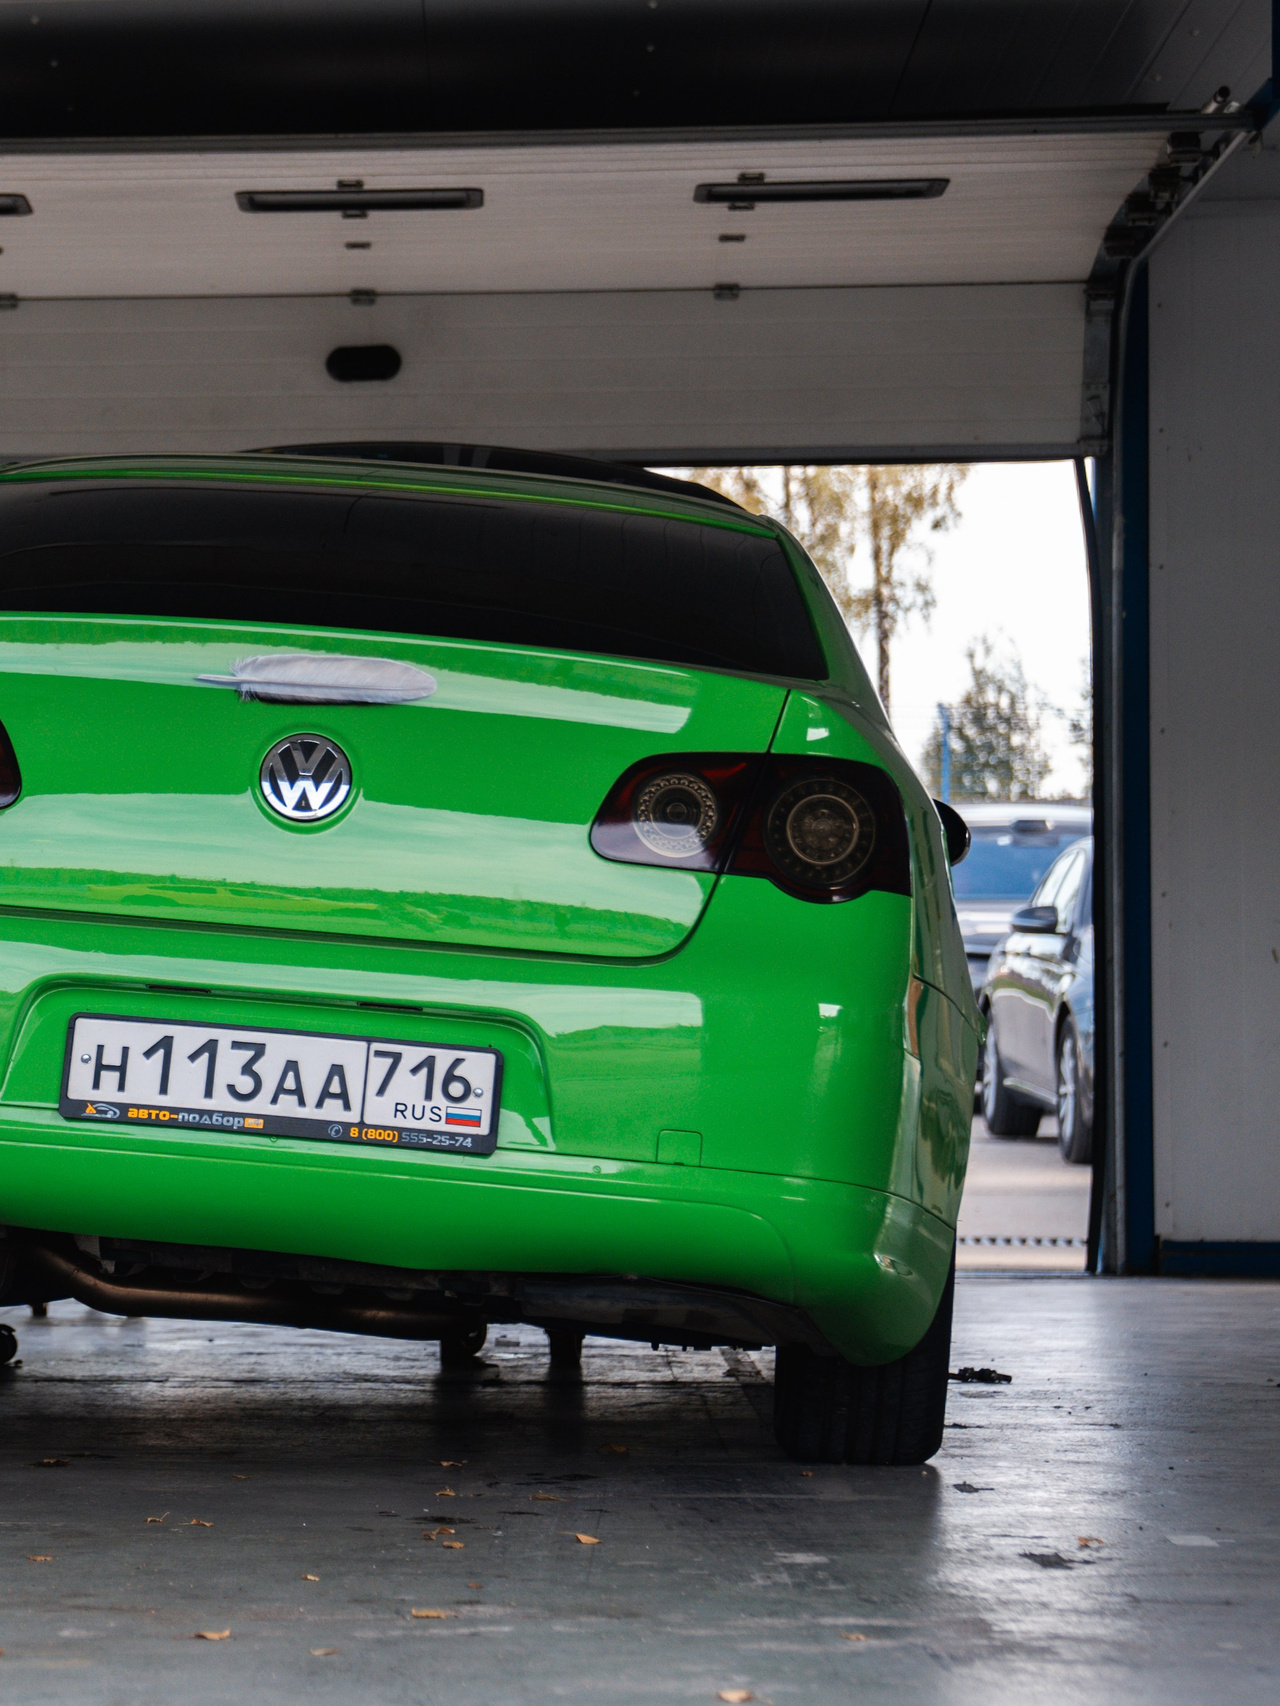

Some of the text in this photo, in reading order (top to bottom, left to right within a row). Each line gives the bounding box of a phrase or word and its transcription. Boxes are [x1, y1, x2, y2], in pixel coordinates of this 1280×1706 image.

[265, 737, 347, 815] VW
[372, 1050, 473, 1104] 716
[394, 1102, 443, 1123] RUS
[349, 1126, 473, 1148] 8 (800) 555-25-74
